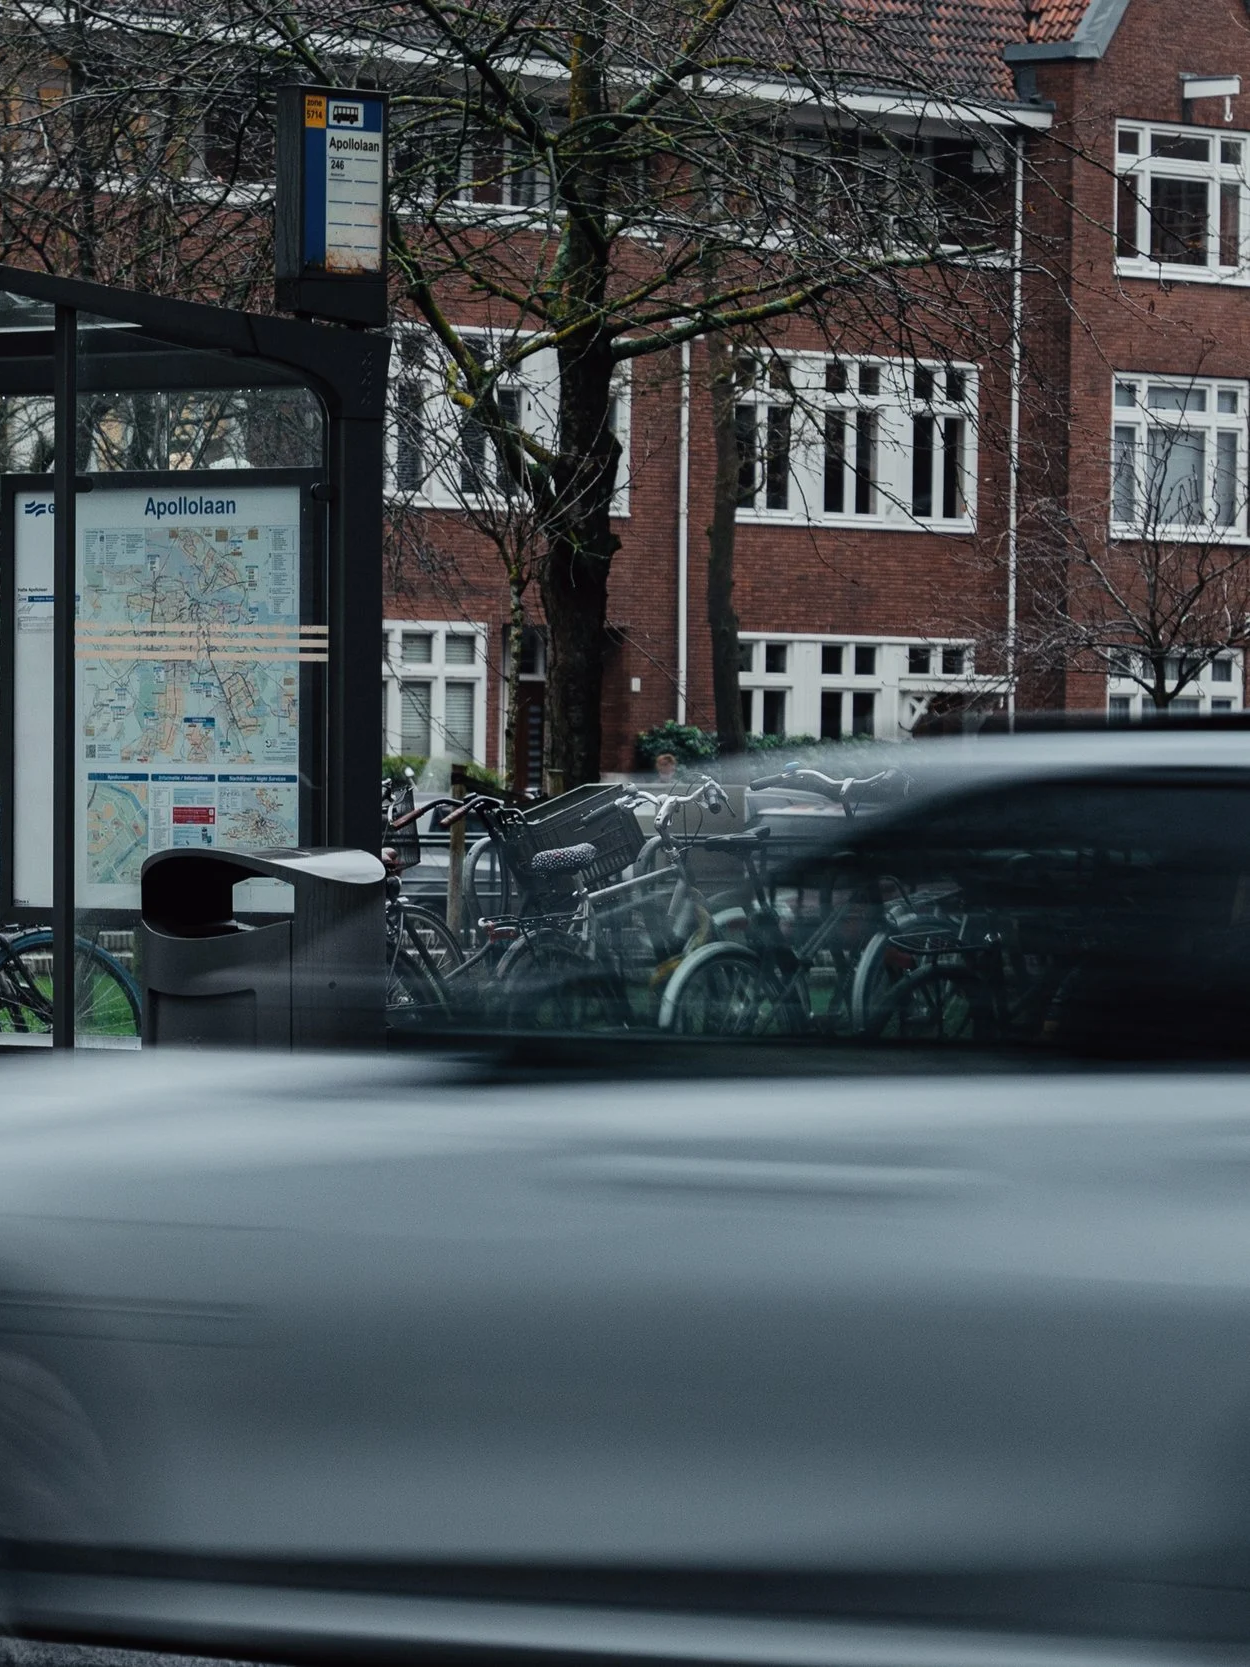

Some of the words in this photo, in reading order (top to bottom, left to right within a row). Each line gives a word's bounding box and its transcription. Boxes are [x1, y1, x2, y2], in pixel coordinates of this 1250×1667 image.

[307, 99, 322, 107] zone
[307, 110, 323, 119] 5714
[329, 136, 380, 153] Apollolaan
[330, 159, 345, 170] 246
[144, 496, 237, 520] Apollolaan
